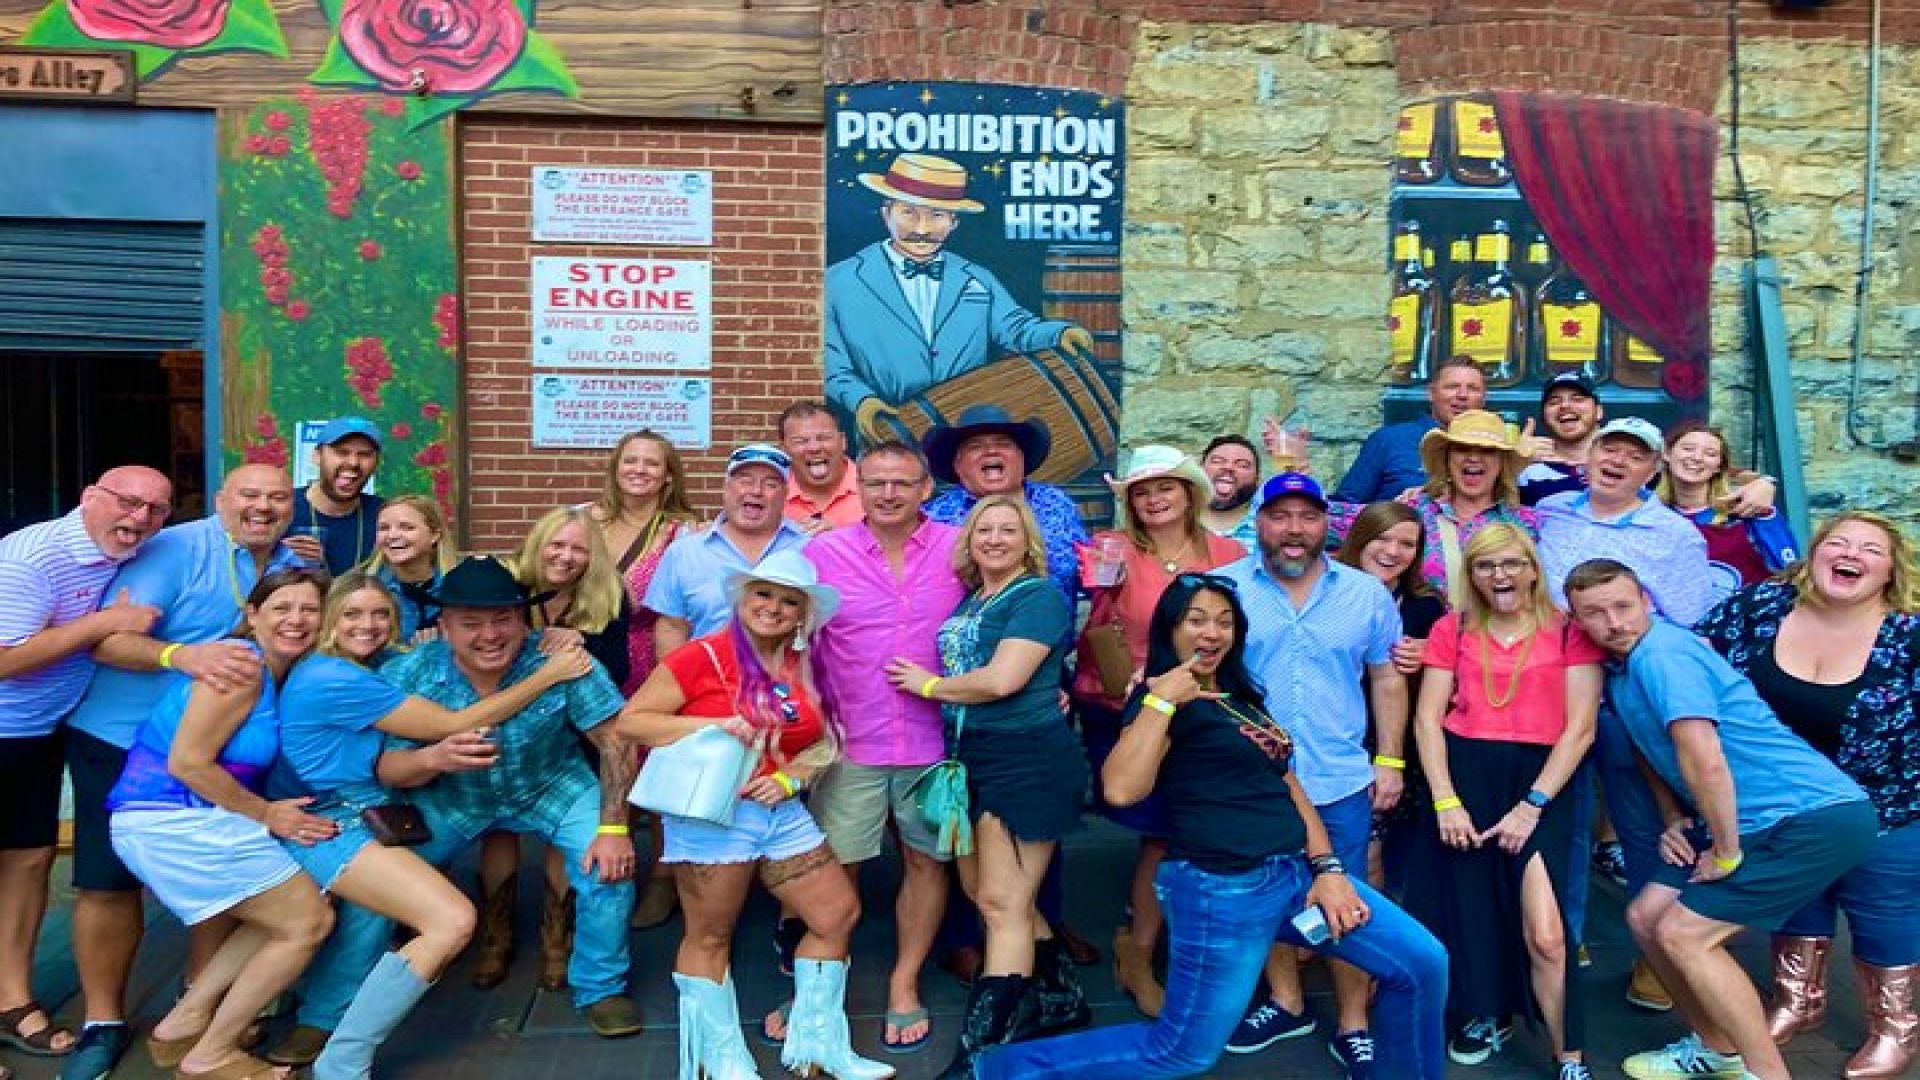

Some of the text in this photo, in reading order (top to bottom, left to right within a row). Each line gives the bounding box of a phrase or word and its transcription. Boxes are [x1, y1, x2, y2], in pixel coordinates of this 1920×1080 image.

[29, 60, 104, 96] Alley
[836, 111, 1116, 155] PROHIBITION
[1010, 160, 1115, 199] ENDS
[555, 193, 688, 205] PLEASE DO NOT BLOCK
[555, 204, 688, 216] THE ENTRANCE GATE
[1004, 203, 1113, 241] HERE.
[569, 263, 676, 284] STOP
[549, 287, 694, 310] ENGINE
[544, 317, 699, 333] WHILE LOADING
[609, 335, 634, 345] OR
[567, 350, 679, 363] UNLOADING
[555, 400, 688, 410] PLEASE DO NOT BLOCK
[555, 411, 688, 421] THE ENTRANCE GATE
